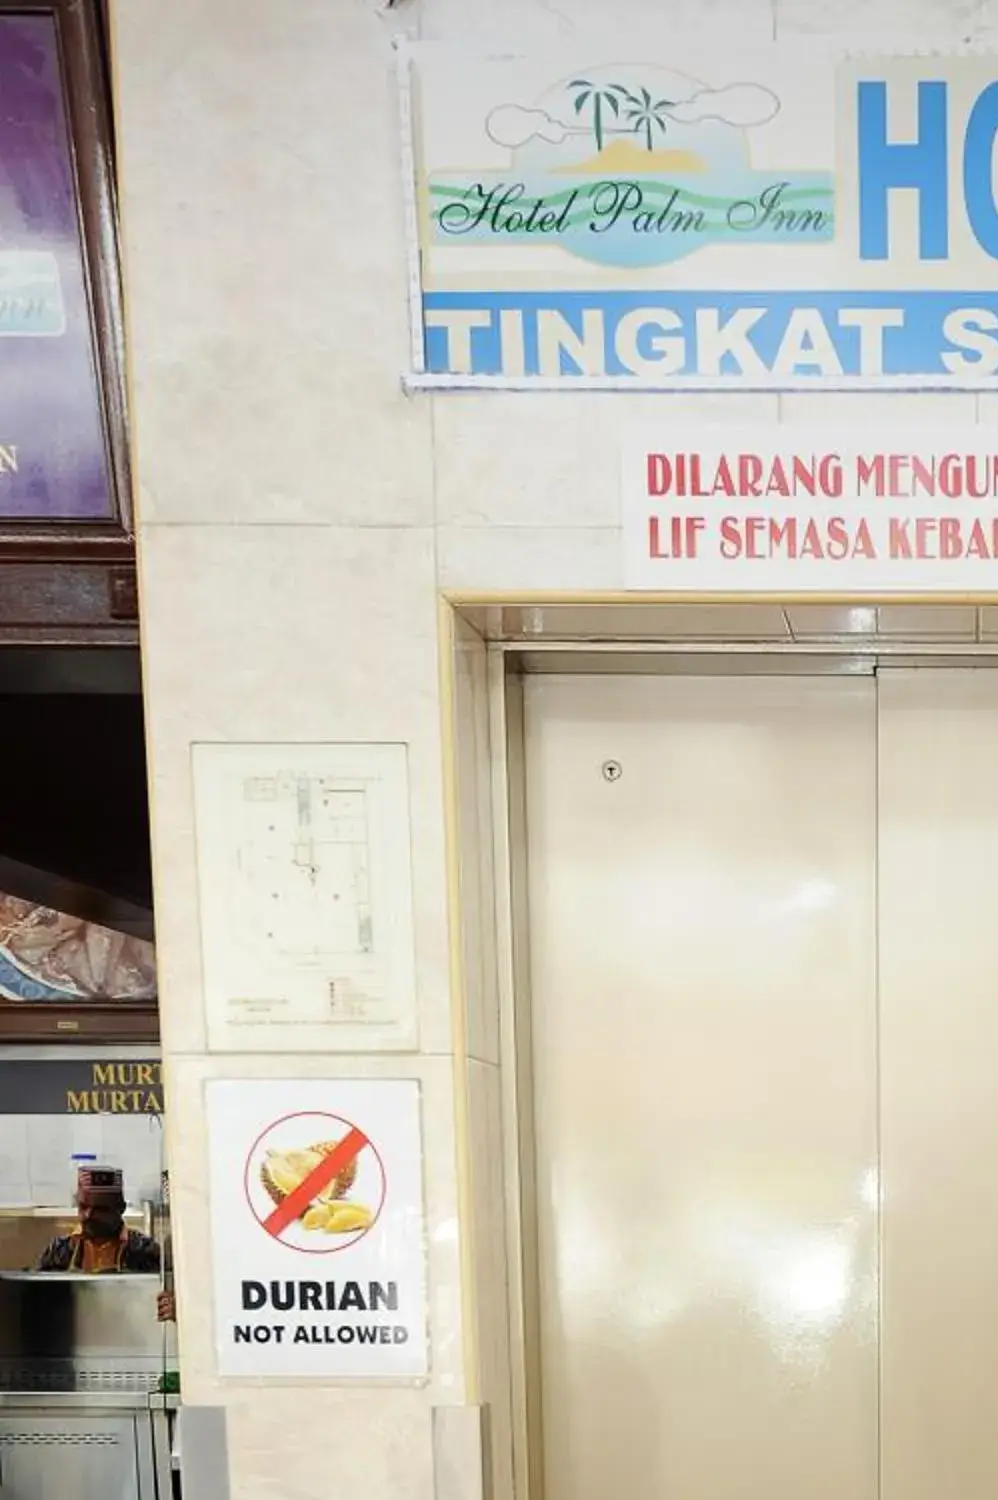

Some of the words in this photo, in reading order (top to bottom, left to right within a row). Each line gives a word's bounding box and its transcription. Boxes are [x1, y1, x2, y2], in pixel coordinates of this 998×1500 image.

[439, 182, 571, 234] Hotel
[588, 179, 707, 234] Palm
[727, 181, 828, 234] Inn
[428, 306, 904, 376] TINGKAT
[646, 453, 844, 498] DILARANG
[648, 515, 706, 560] LIF
[719, 515, 878, 560] SEMASA
[241, 1280, 398, 1311] DURIAN
[233, 1325, 285, 1344] NOT
[293, 1325, 409, 1345] ALLOWED
